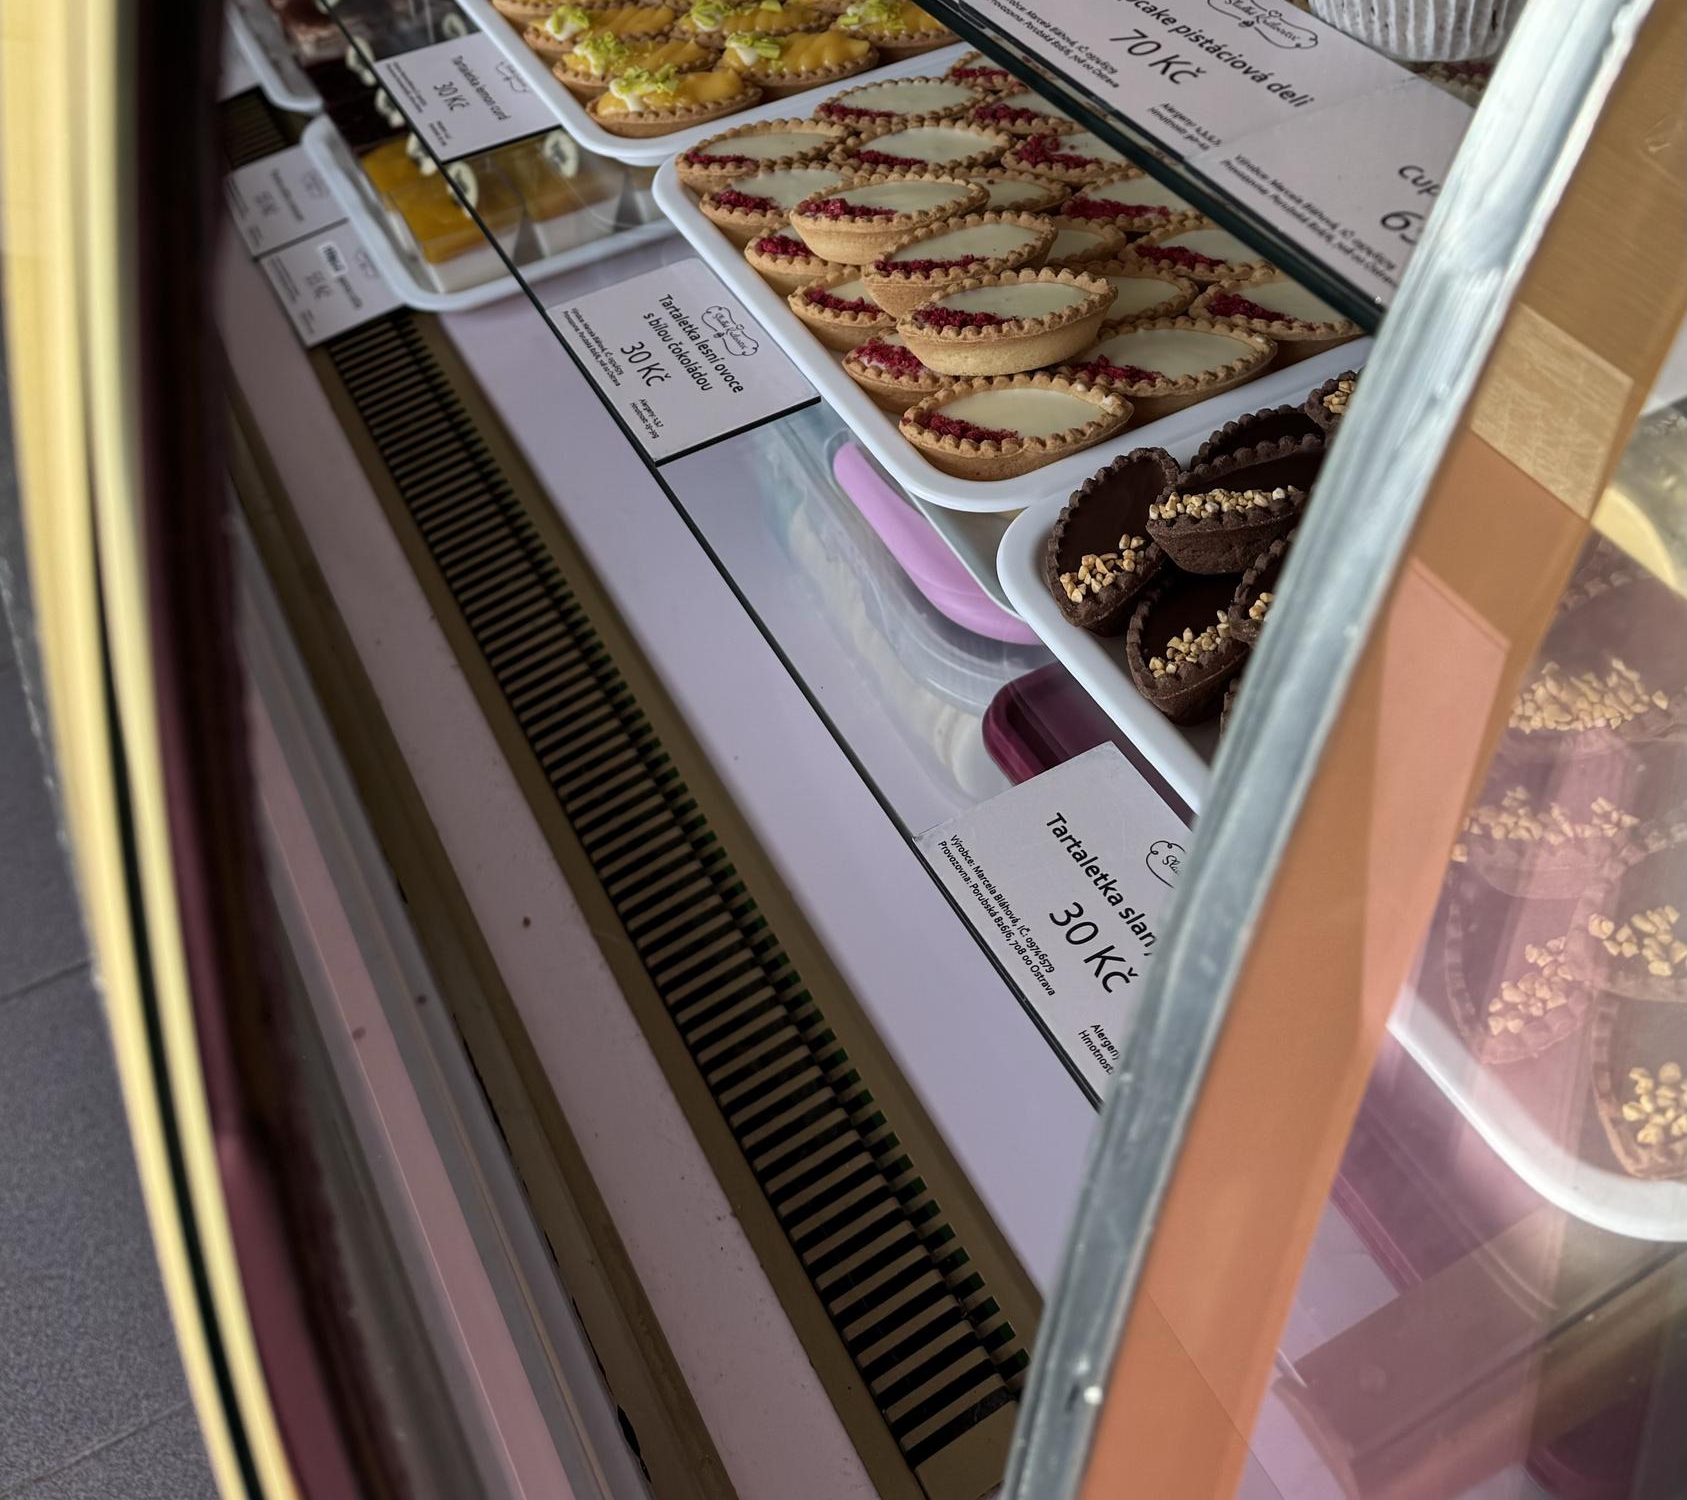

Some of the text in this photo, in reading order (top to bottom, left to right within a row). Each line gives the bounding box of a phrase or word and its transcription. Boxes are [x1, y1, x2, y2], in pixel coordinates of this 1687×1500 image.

[433, 81, 458, 97] 30
[1109, 28, 1207, 85] 70 Kč
[1168, 21, 1270, 85] pistáciová
[1266, 81, 1315, 108] deli
[445, 94, 471, 111] Kč
[620, 341, 672, 387] 30 Kč
[643, 312, 713, 392] s bílou čokoládou
[659, 293, 744, 394] Tartaletka lesní ovoce
[938, 840, 1056, 997] Provozovna: Porubská 826/6, 708 00 Ostrava
[950, 834, 1055, 974] Výrobce: Marcela Bláhová, IČ: 09746579
[1046, 812, 1158, 956] Tartaletka slan
[1049, 901, 1139, 994] 30 Kč
